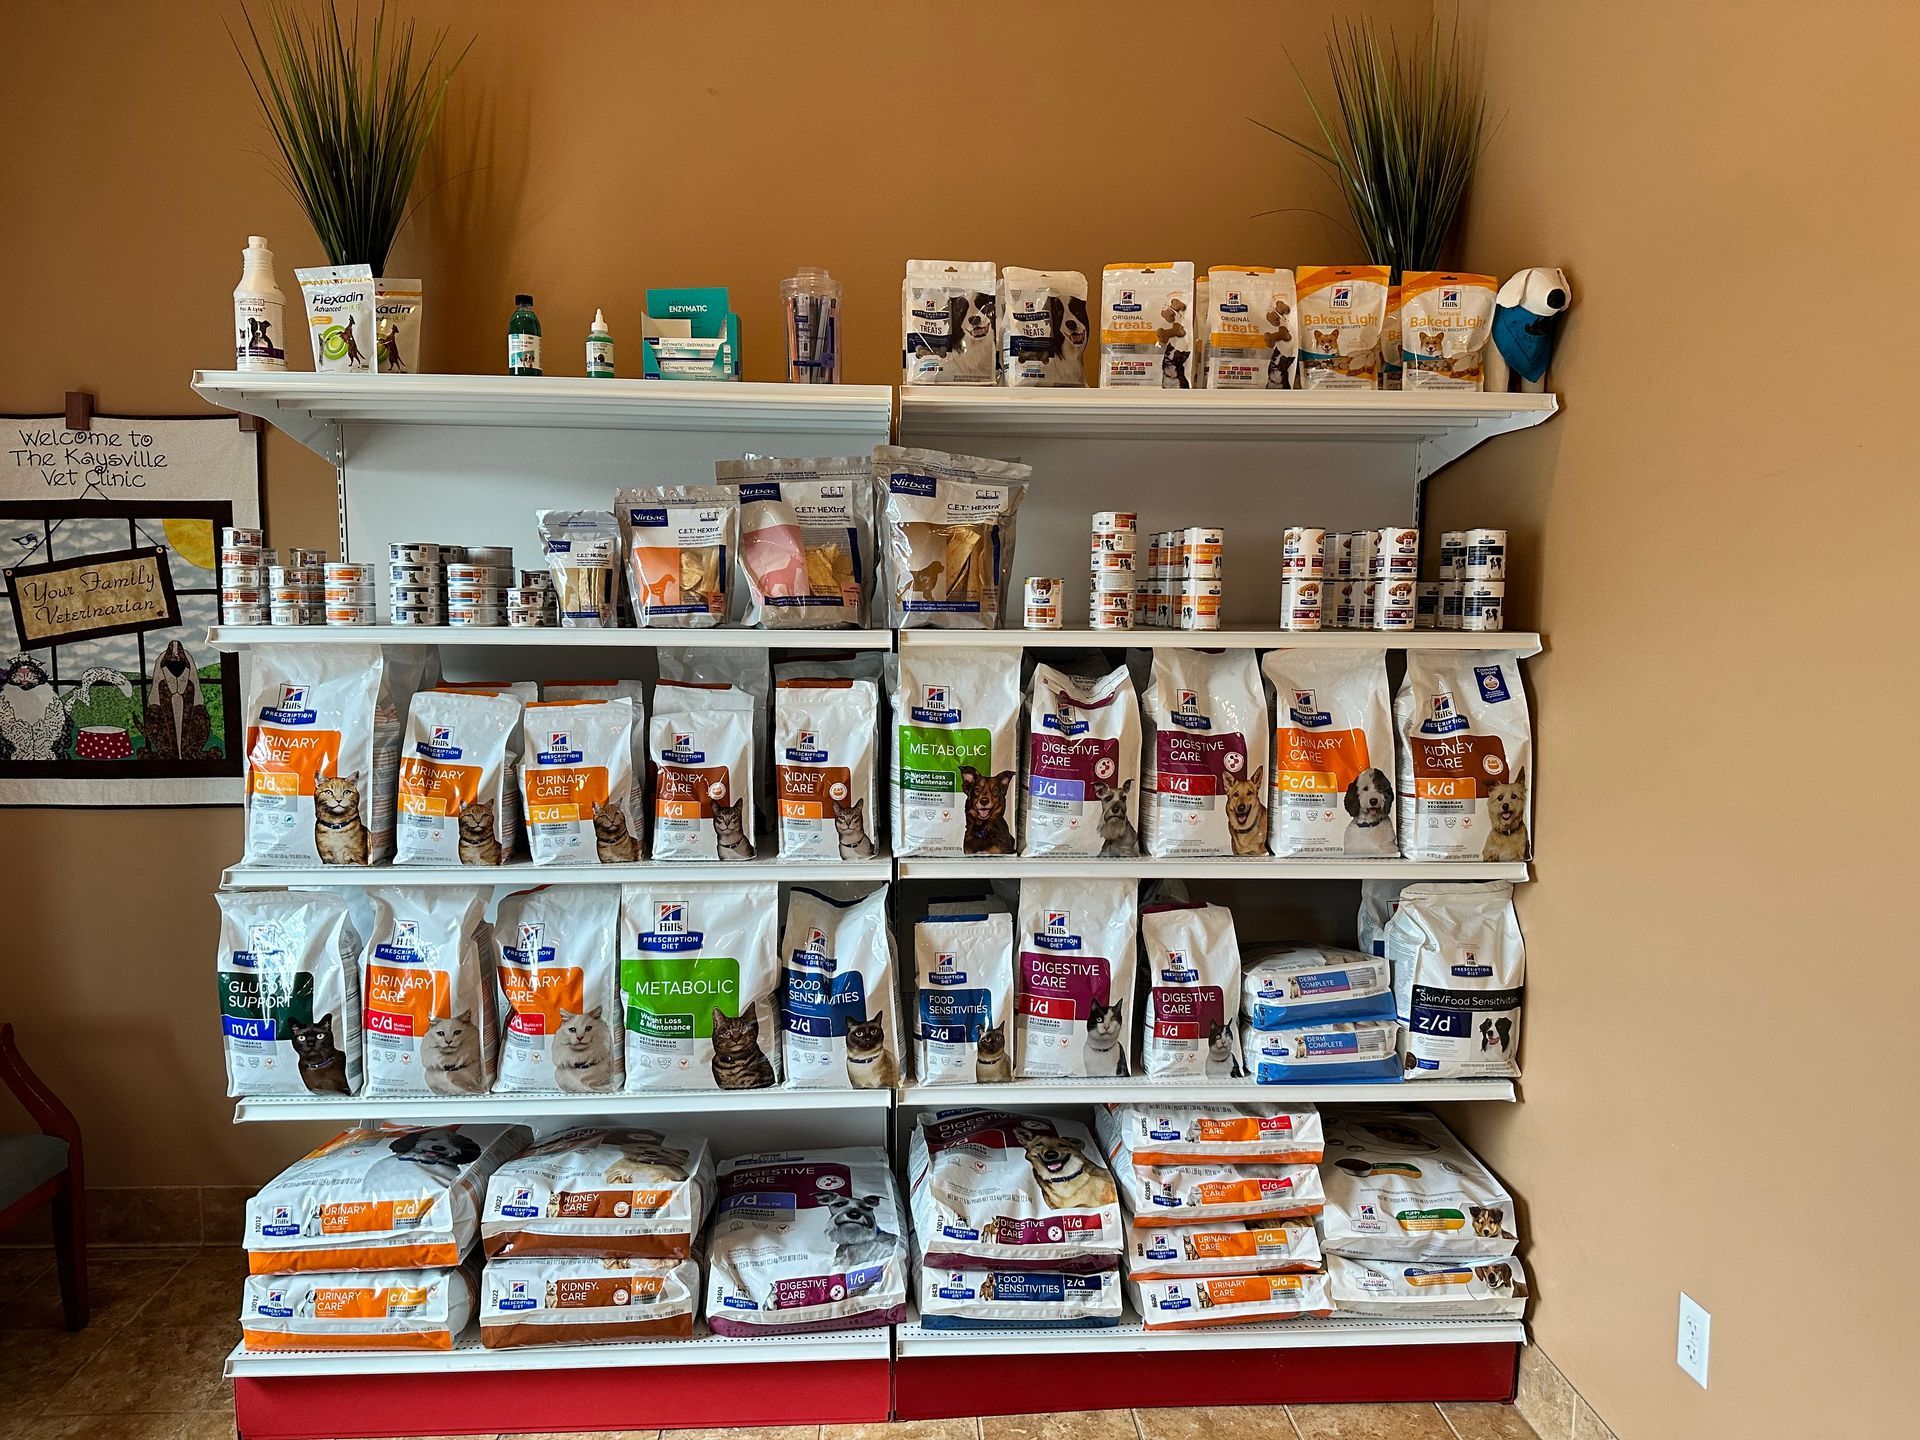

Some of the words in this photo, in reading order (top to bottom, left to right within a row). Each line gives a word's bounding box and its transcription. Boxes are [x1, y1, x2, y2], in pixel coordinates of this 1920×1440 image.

[669, 305, 707, 313] ENZYMATIC
[1113, 321, 1152, 329] treats
[1304, 315, 1344, 326] Baked
[1349, 313, 1378, 326] Light
[1410, 316, 1451, 327] Baked
[1456, 316, 1486, 329] Light
[920, 325, 942, 334] TREATS
[1023, 328, 1044, 336] TREATS
[1222, 323, 1259, 333] treats
[19, 429, 122, 447] Welcome
[129, 431, 153, 447] to
[9, 450, 55, 466] The
[65, 448, 168, 473] Kaysville
[41, 469, 78, 486] Vet
[85, 470, 146, 487] Clinic
[892, 479, 932, 490] Virbac
[24, 582, 75, 607] Your
[80, 565, 155, 592] Family
[36, 600, 155, 625] Veterinarian
[915, 710, 959, 719] PRESCRIPTION
[1170, 739, 1224, 750] DIGESTIVE
[1290, 735, 1343, 749] URINARY
[910, 744, 987, 756] METABOLIC
[1041, 743, 1099, 755] DIGESTIVE
[1424, 743, 1473, 756] KIDNEY
[1041, 755, 1070, 767] CARE
[1170, 751, 1201, 761] CARE
[1290, 750, 1322, 762] CARE
[1427, 757, 1463, 768] CARE
[412, 765, 464, 779] URINARY
[666, 772, 703, 783] KIDNEY
[786, 772, 824, 783] KIDNEY
[257, 777, 275, 790] c/d
[409, 777, 441, 790] CARE
[536, 773, 589, 785] URINARY
[1169, 778, 1189, 791] i/d
[1290, 776, 1315, 788] c/d
[537, 785, 569, 796] CARE
[666, 783, 692, 793] CARE
[786, 783, 814, 793] CARE
[1428, 782, 1454, 795] k/d
[538, 808, 559, 820] c/d
[664, 804, 683, 816] k/d
[786, 805, 805, 816] k/d
[659, 922, 682, 932] Hill's
[1037, 936, 1079, 944] PRESCRIPTION
[1032, 960, 1100, 976] DIGESTIVE
[373, 974, 433, 989] URINARY
[789, 977, 820, 990] FOOD
[1031, 975, 1066, 988] CARE
[1301, 980, 1334, 988] COMPLETE
[636, 980, 733, 995] METABOLIC
[372, 988, 406, 1002] CARE
[506, 990, 534, 1002] CARE
[788, 989, 859, 1004] SENSITIVITIES
[929, 995, 954, 1004] FOOD
[1162, 990, 1216, 1003] DIGESTIVE
[1420, 993, 1469, 1005] Skin/Food
[229, 995, 293, 1008] SUPPORT
[929, 1004, 988, 1015] SENSITIVITIES
[1030, 1001, 1049, 1014] i/d
[1162, 1003, 1191, 1014] CARE
[372, 1016, 392, 1030] c/d
[790, 1018, 810, 1032] z/d
[1419, 1015, 1450, 1031] z/d
[232, 1023, 258, 1037] m/d
[930, 1027, 949, 1040] z/d
[1161, 1024, 1178, 1037] i/d
[1202, 1120, 1235, 1128] URINARY
[1261, 1120, 1276, 1129] c/d
[734, 1167, 815, 1182] DIGESTIVE
[733, 1176, 776, 1188] CARE
[1202, 1183, 1236, 1191] URINARY
[1262, 1182, 1277, 1190] c/d
[564, 1194, 599, 1203] KIDNEY
[636, 1192, 656, 1204] k/d
[729, 1194, 757, 1206] i/d
[324, 1206, 366, 1216] URINARY
[395, 1204, 415, 1215] c/d
[563, 1203, 588, 1212] CARE
[323, 1216, 349, 1225] CARE
[936, 1215, 944, 1232] 10013
[1001, 1220, 1044, 1229] DIGESTIVE
[1067, 1219, 1082, 1228] i/d
[1001, 1230, 1023, 1238] CARE
[1198, 1234, 1232, 1243] URINARY
[1257, 1233, 1273, 1242] c/d
[1200, 1243, 1220, 1251] CARE
[850, 1273, 865, 1284] i/d
[998, 1275, 1025, 1284] FOOD
[1067, 1279, 1085, 1287] z/d
[1211, 1280, 1246, 1288] URINARY
[1271, 1277, 1287, 1287] c/d
[561, 1282, 595, 1291] KIDNEY
[636, 1280, 655, 1291] k/d
[780, 1279, 828, 1290] DIGESTIVE
[998, 1284, 1059, 1293] SENSITIVITIES
[318, 1292, 360, 1300] URINARY
[390, 1293, 408, 1302] c/d
[491, 1290, 499, 1307] 10022
[561, 1292, 587, 1301] CARE
[781, 1290, 805, 1300] CARE
[251, 1295, 259, 1312] 10012
[317, 1301, 343, 1311] CARE
